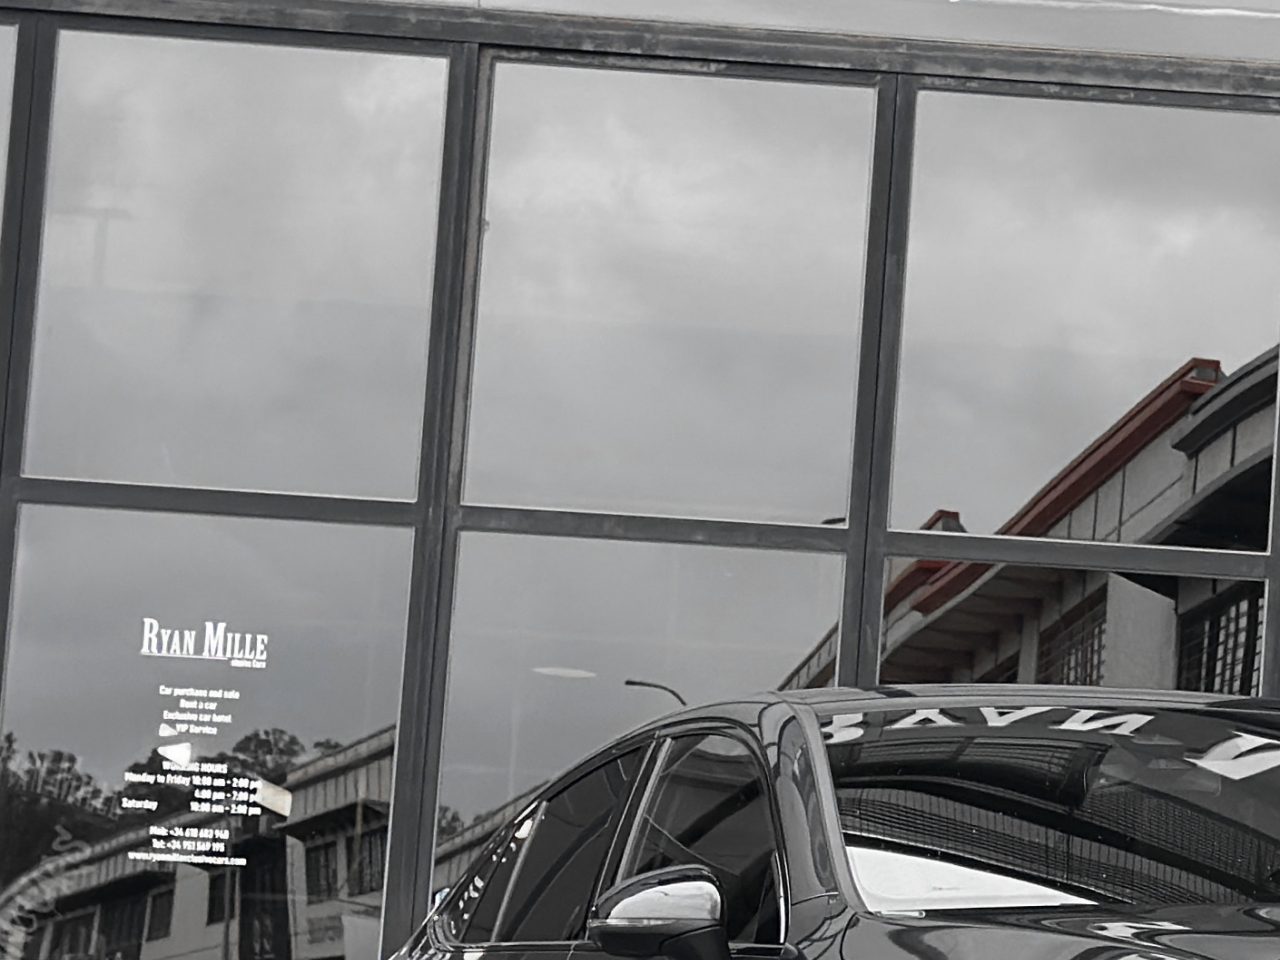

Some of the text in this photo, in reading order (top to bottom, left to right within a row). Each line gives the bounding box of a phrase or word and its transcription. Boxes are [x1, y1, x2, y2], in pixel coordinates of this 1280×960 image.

[142, 618, 268, 660] RYAN MILLE
[121, 797, 158, 811] Saturday
